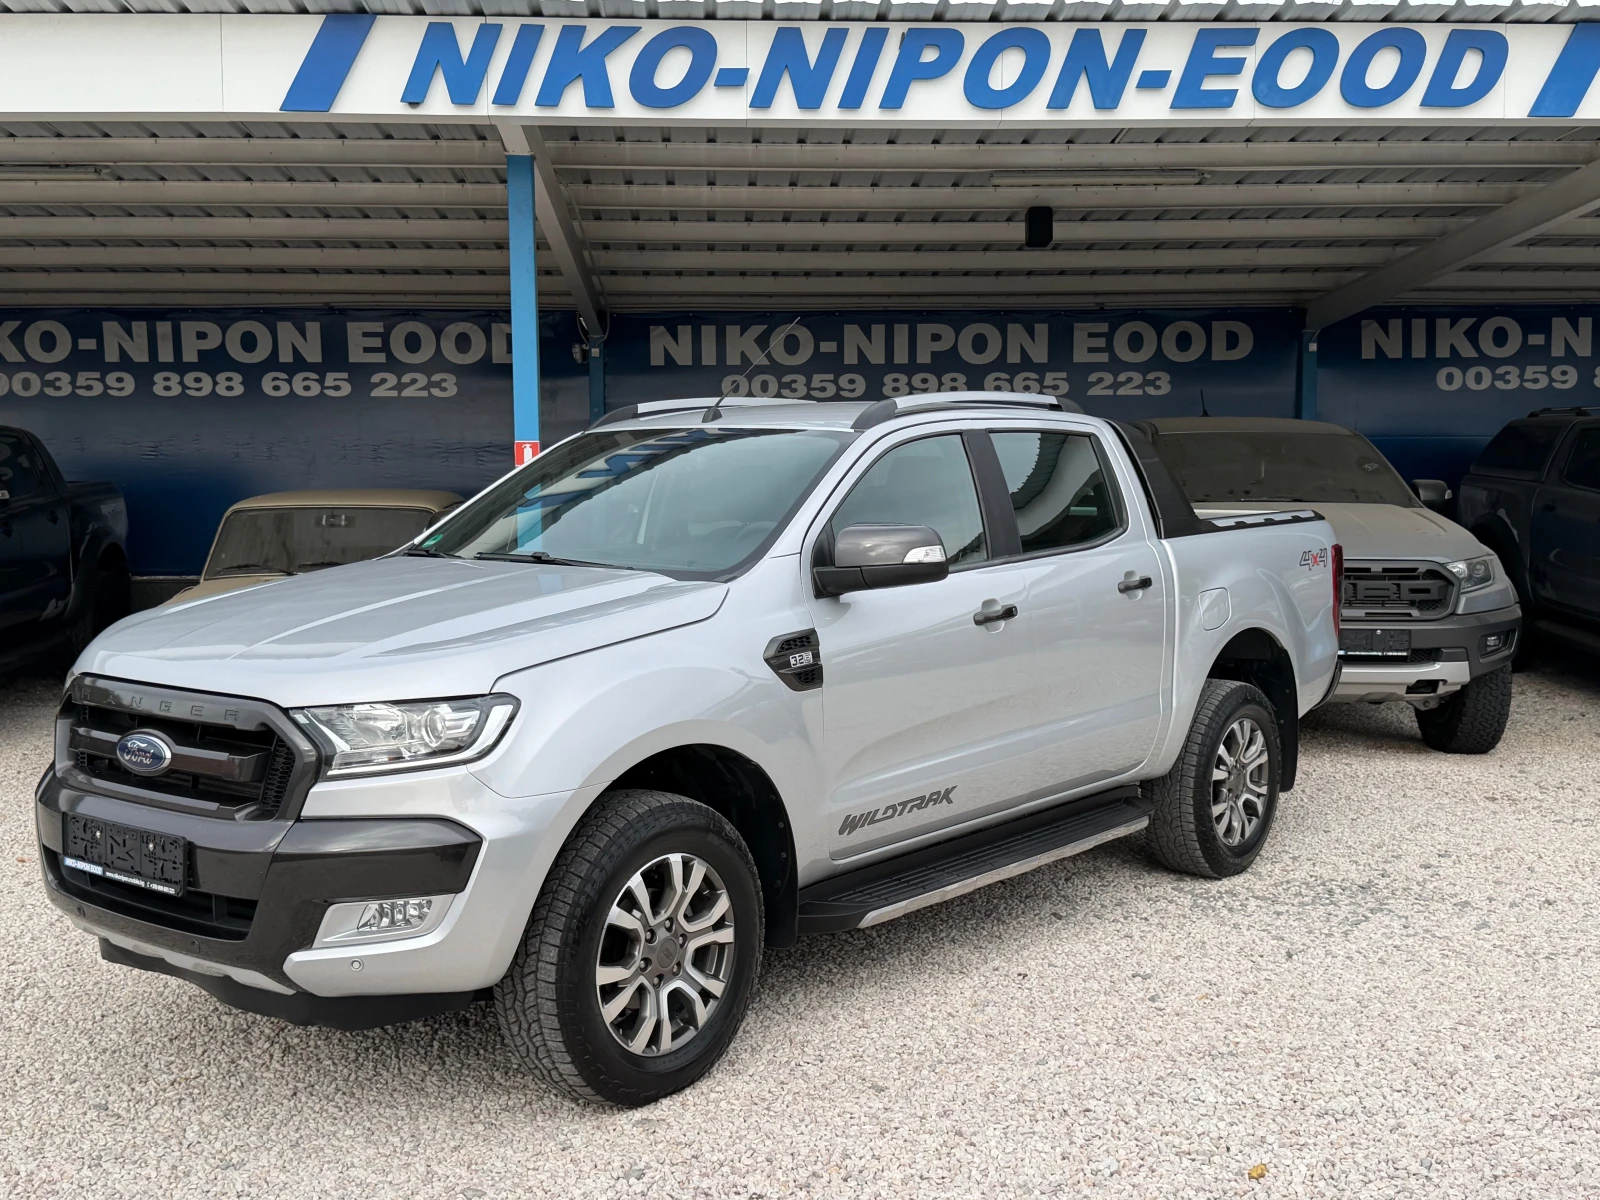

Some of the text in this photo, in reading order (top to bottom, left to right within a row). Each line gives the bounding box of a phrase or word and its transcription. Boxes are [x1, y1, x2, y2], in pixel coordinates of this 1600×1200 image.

[401, 22, 1508, 110] NIKO-NIPON-EOOD
[650, 321, 1254, 368] NIKO-NIPON EOOD
[1361, 316, 1593, 360] NIKO-N
[153, 372, 245, 398] 898
[261, 372, 352, 398] 665
[370, 372, 459, 398] 223
[721, 371, 1171, 398] 00359 898 665 223
[1436, 364, 1579, 391] 00359
[80, 687, 239, 721] RANGER
[123, 739, 154, 765] Ford
[838, 784, 958, 836] WILDTRAK
